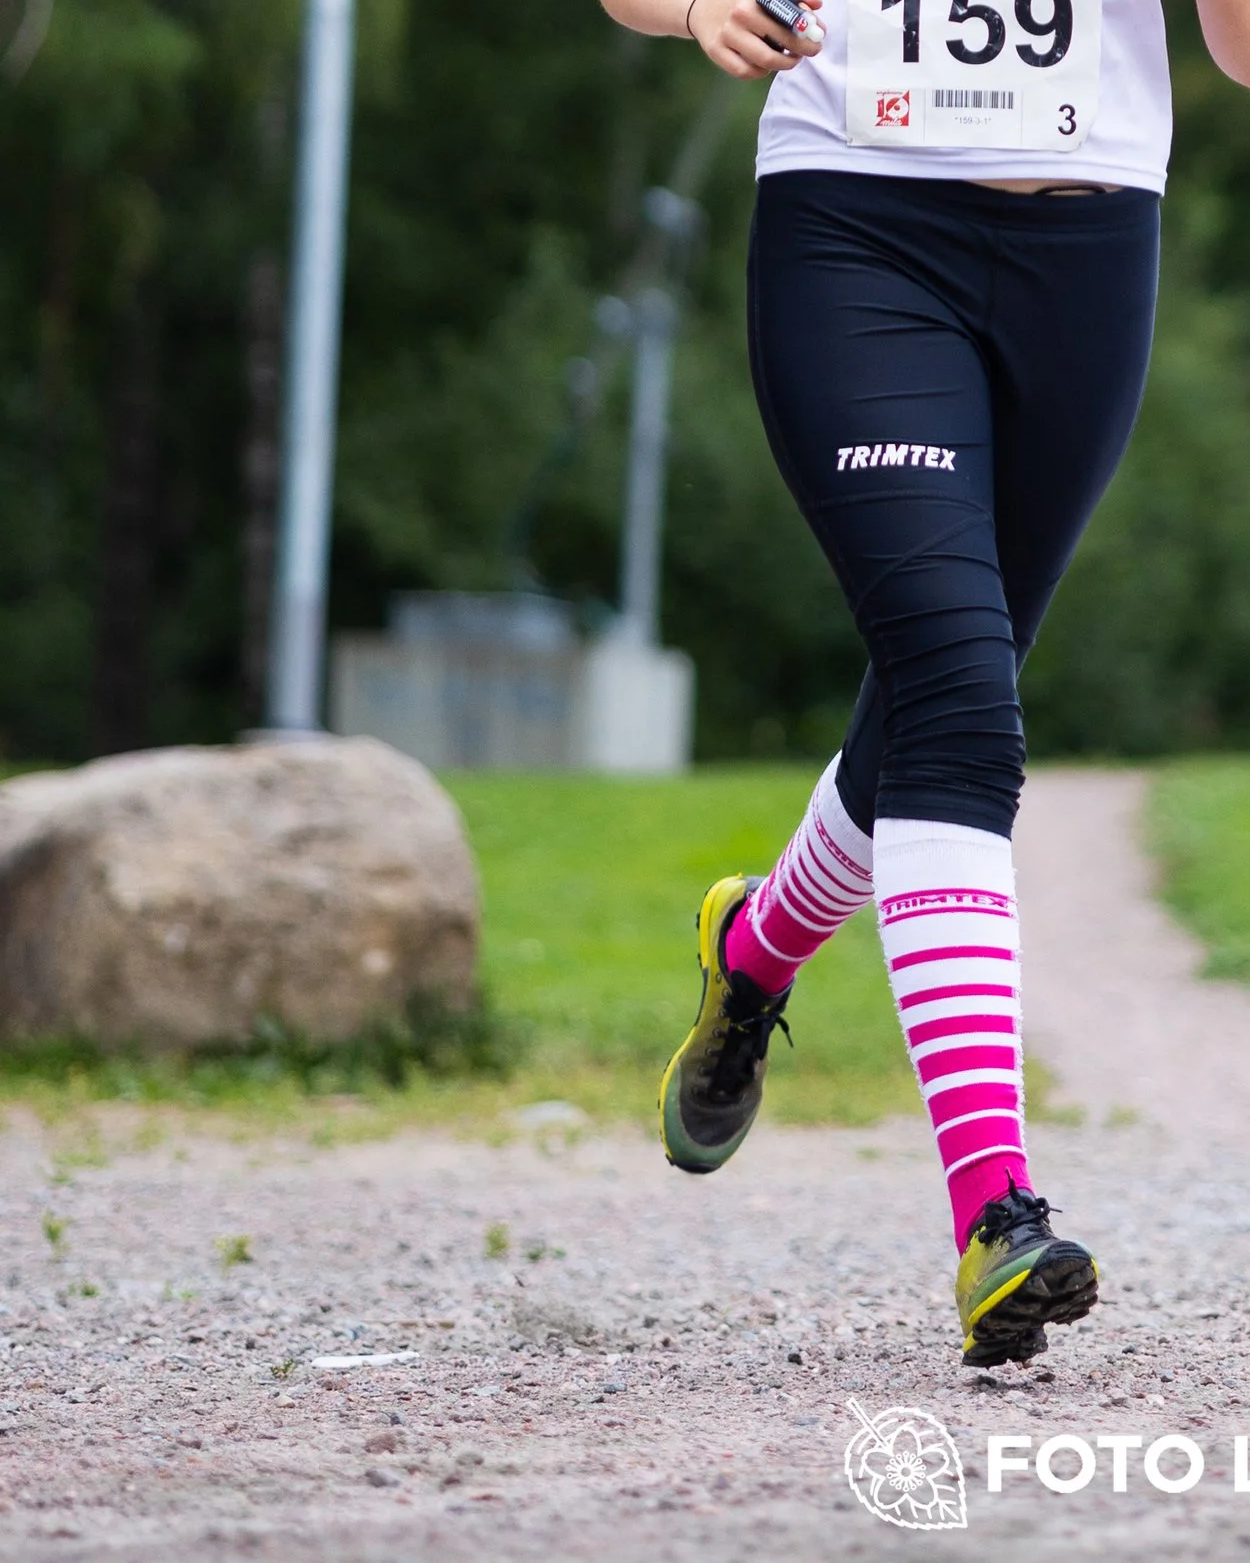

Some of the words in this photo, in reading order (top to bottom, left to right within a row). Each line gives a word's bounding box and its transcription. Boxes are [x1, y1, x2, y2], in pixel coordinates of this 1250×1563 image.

[1057, 104, 1077, 135] 3
[837, 444, 956, 471] TRIMTEX
[881, 894, 1008, 916] TRIMTEX
